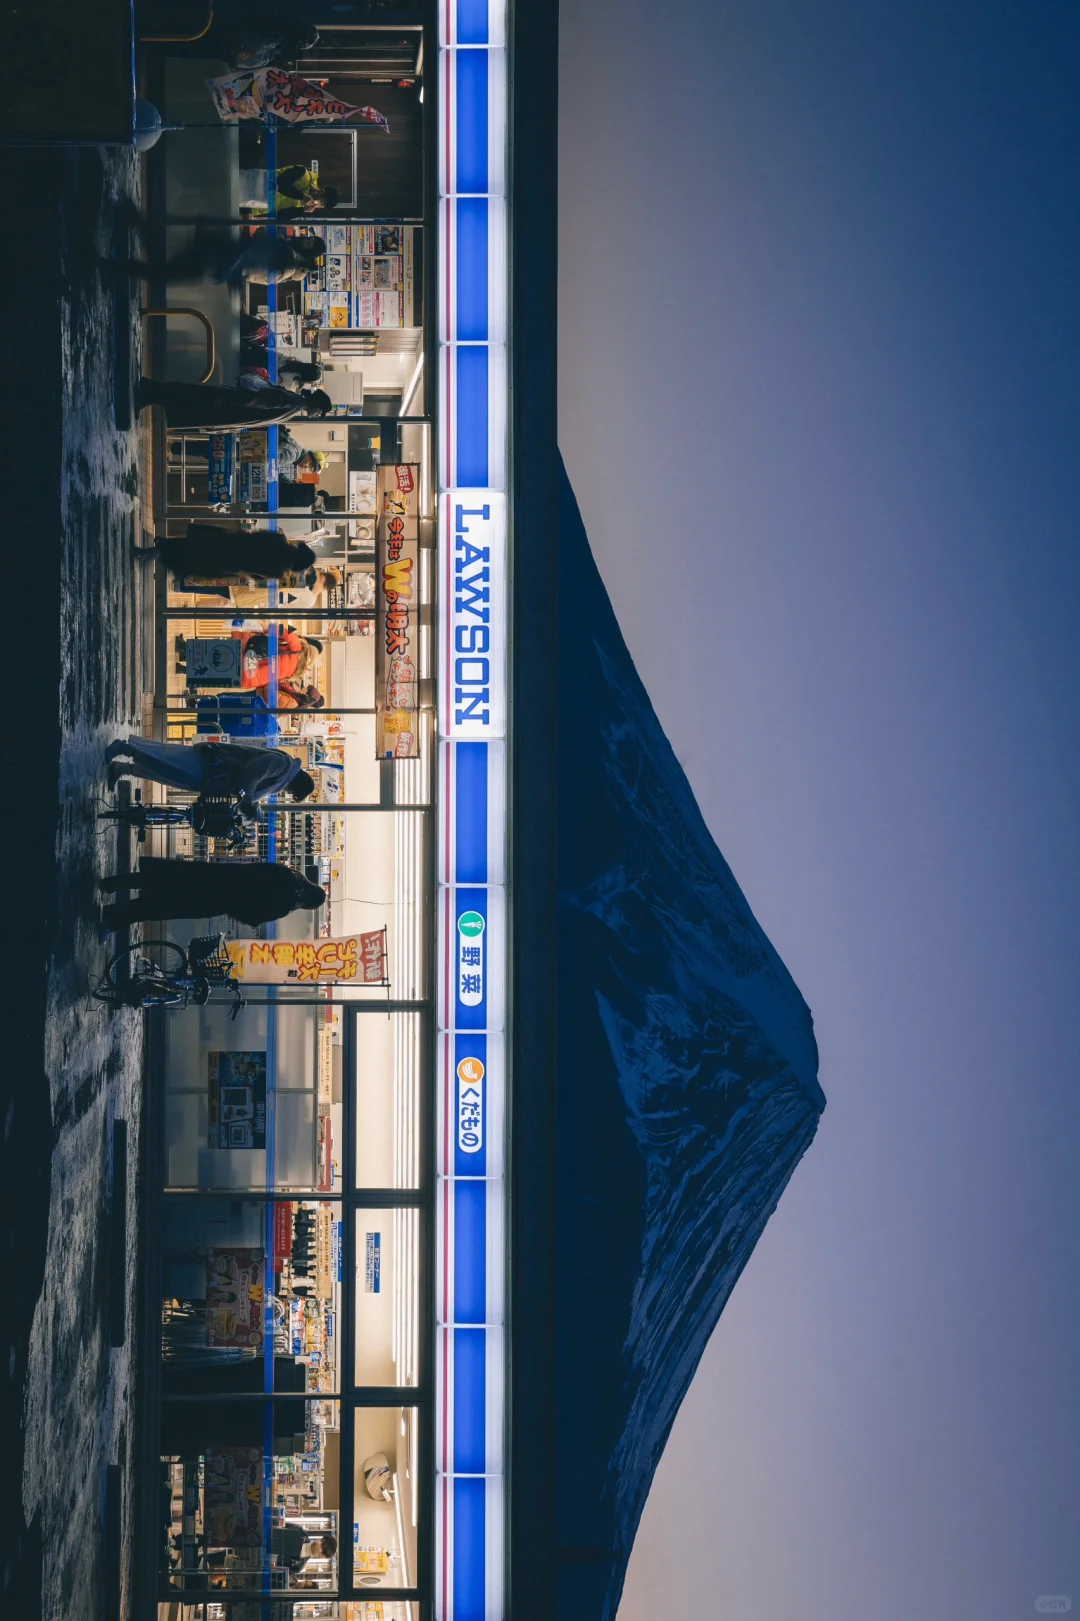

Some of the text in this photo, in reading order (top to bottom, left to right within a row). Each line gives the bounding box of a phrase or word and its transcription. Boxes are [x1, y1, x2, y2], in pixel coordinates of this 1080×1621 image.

[455, 504, 490, 725] LAWSON
[461, 946, 480, 994] 野菜
[461, 1087, 480, 1147] くだもの
